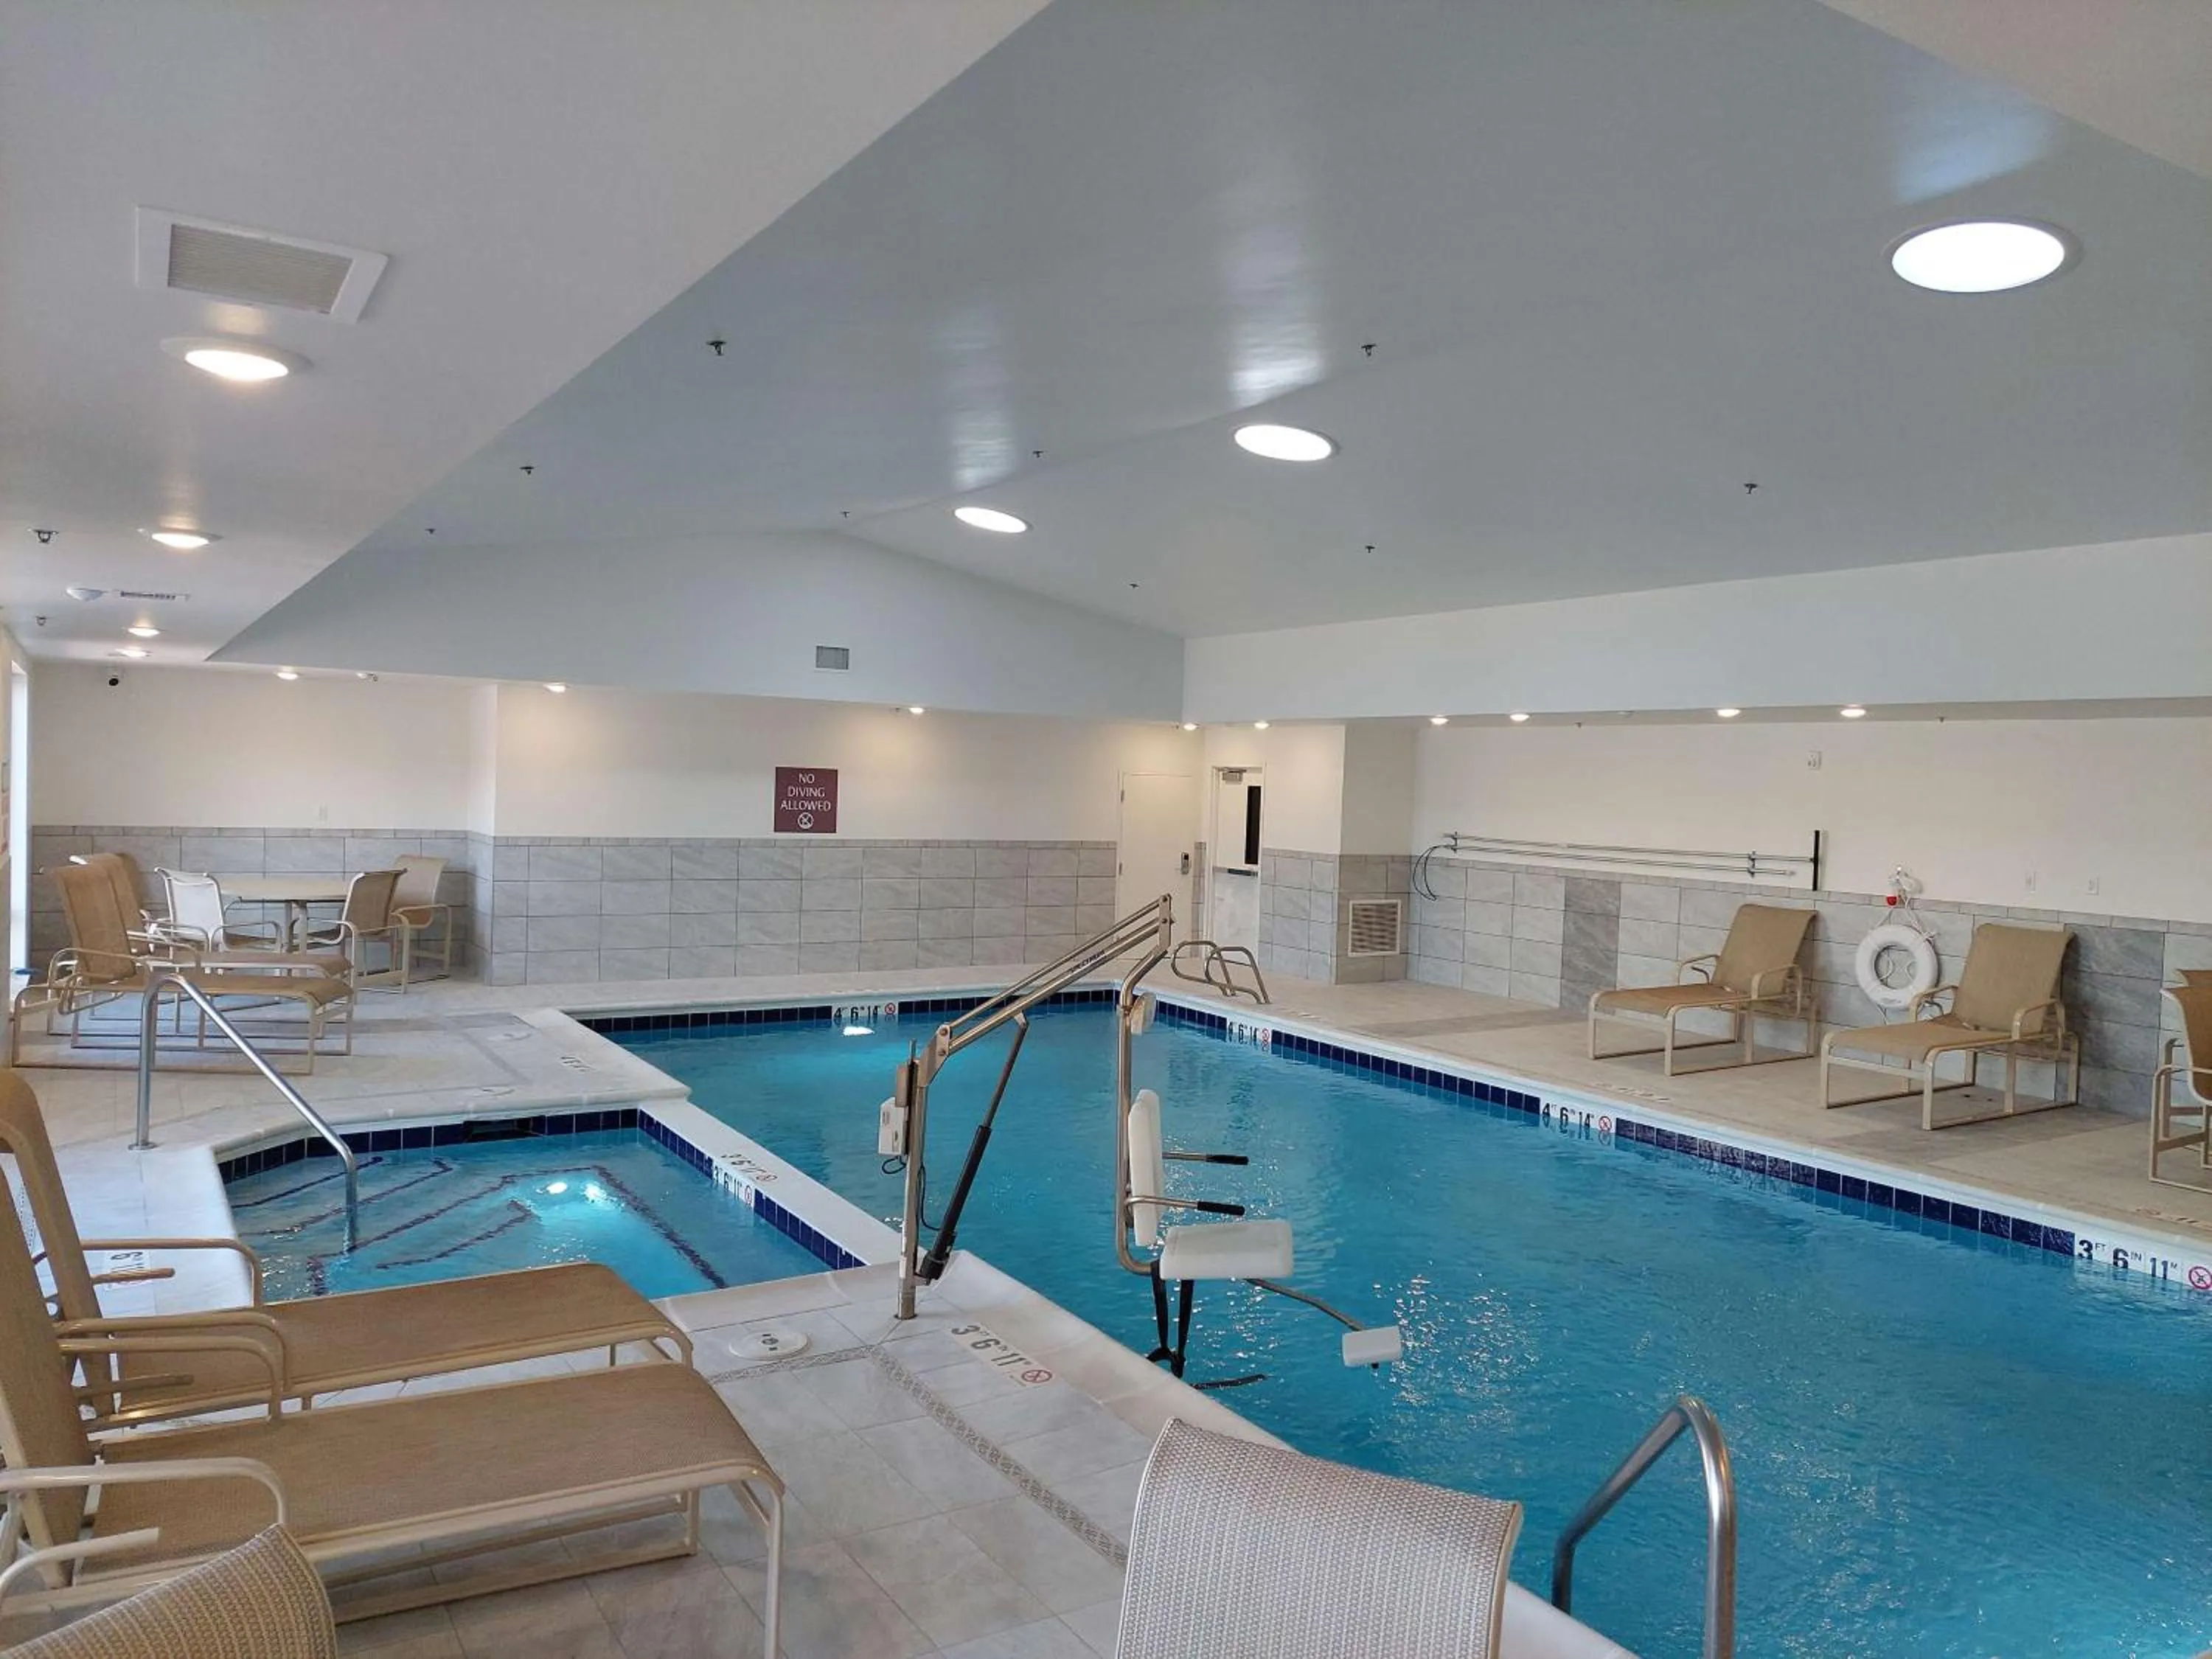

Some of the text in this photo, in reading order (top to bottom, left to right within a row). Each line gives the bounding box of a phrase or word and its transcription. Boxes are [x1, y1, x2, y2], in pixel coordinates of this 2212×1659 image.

[798, 773, 815, 784] NO
[787, 786, 825, 797] DIVING
[780, 799, 831, 812] ALLOWED
